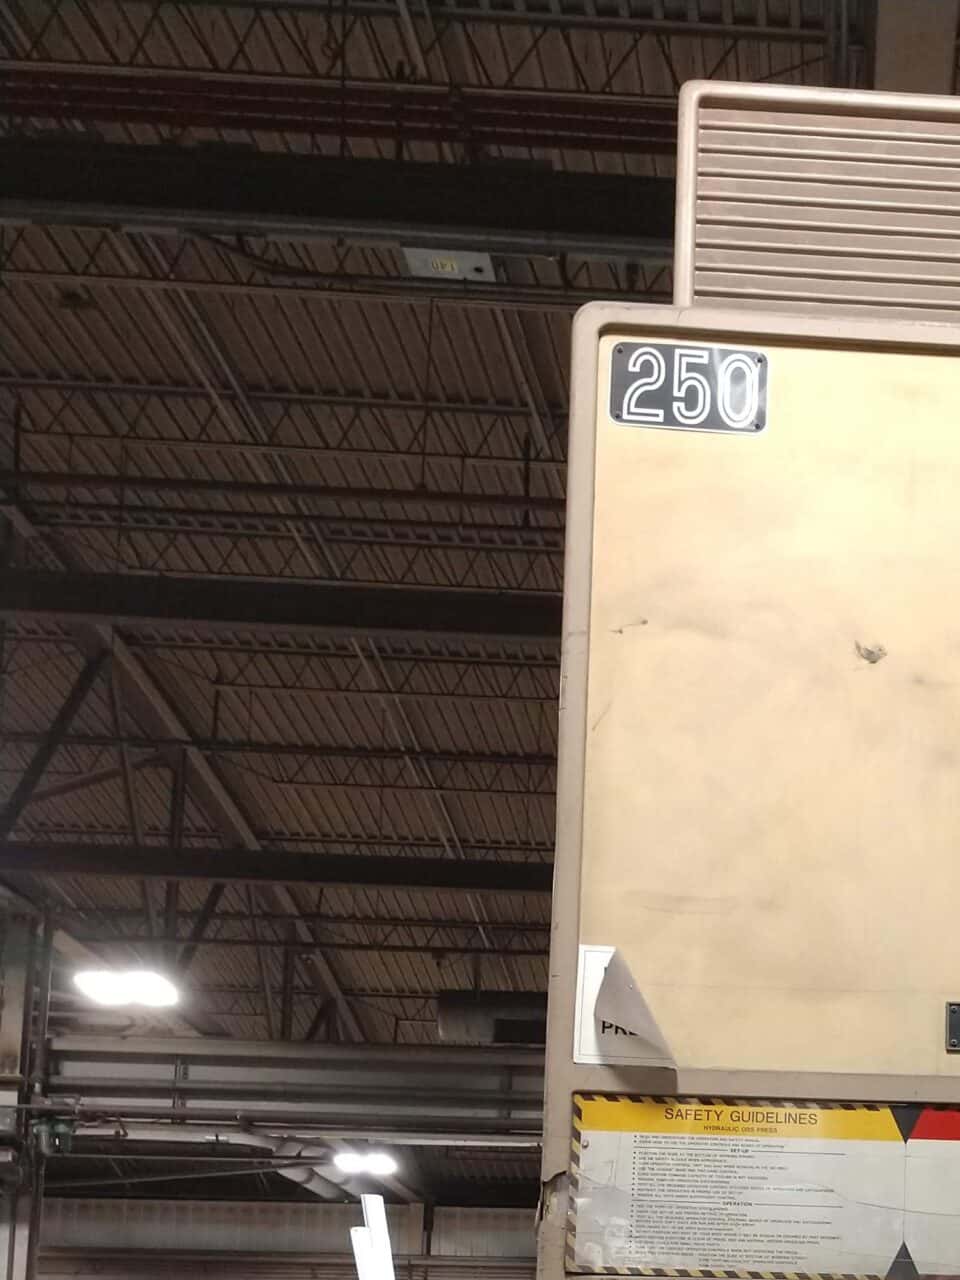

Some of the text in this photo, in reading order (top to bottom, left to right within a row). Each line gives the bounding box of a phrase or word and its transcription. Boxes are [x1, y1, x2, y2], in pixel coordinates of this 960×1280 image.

[622, 346, 759, 428] 250
[664, 1108, 818, 1125] SAFETY GUIDELINES
